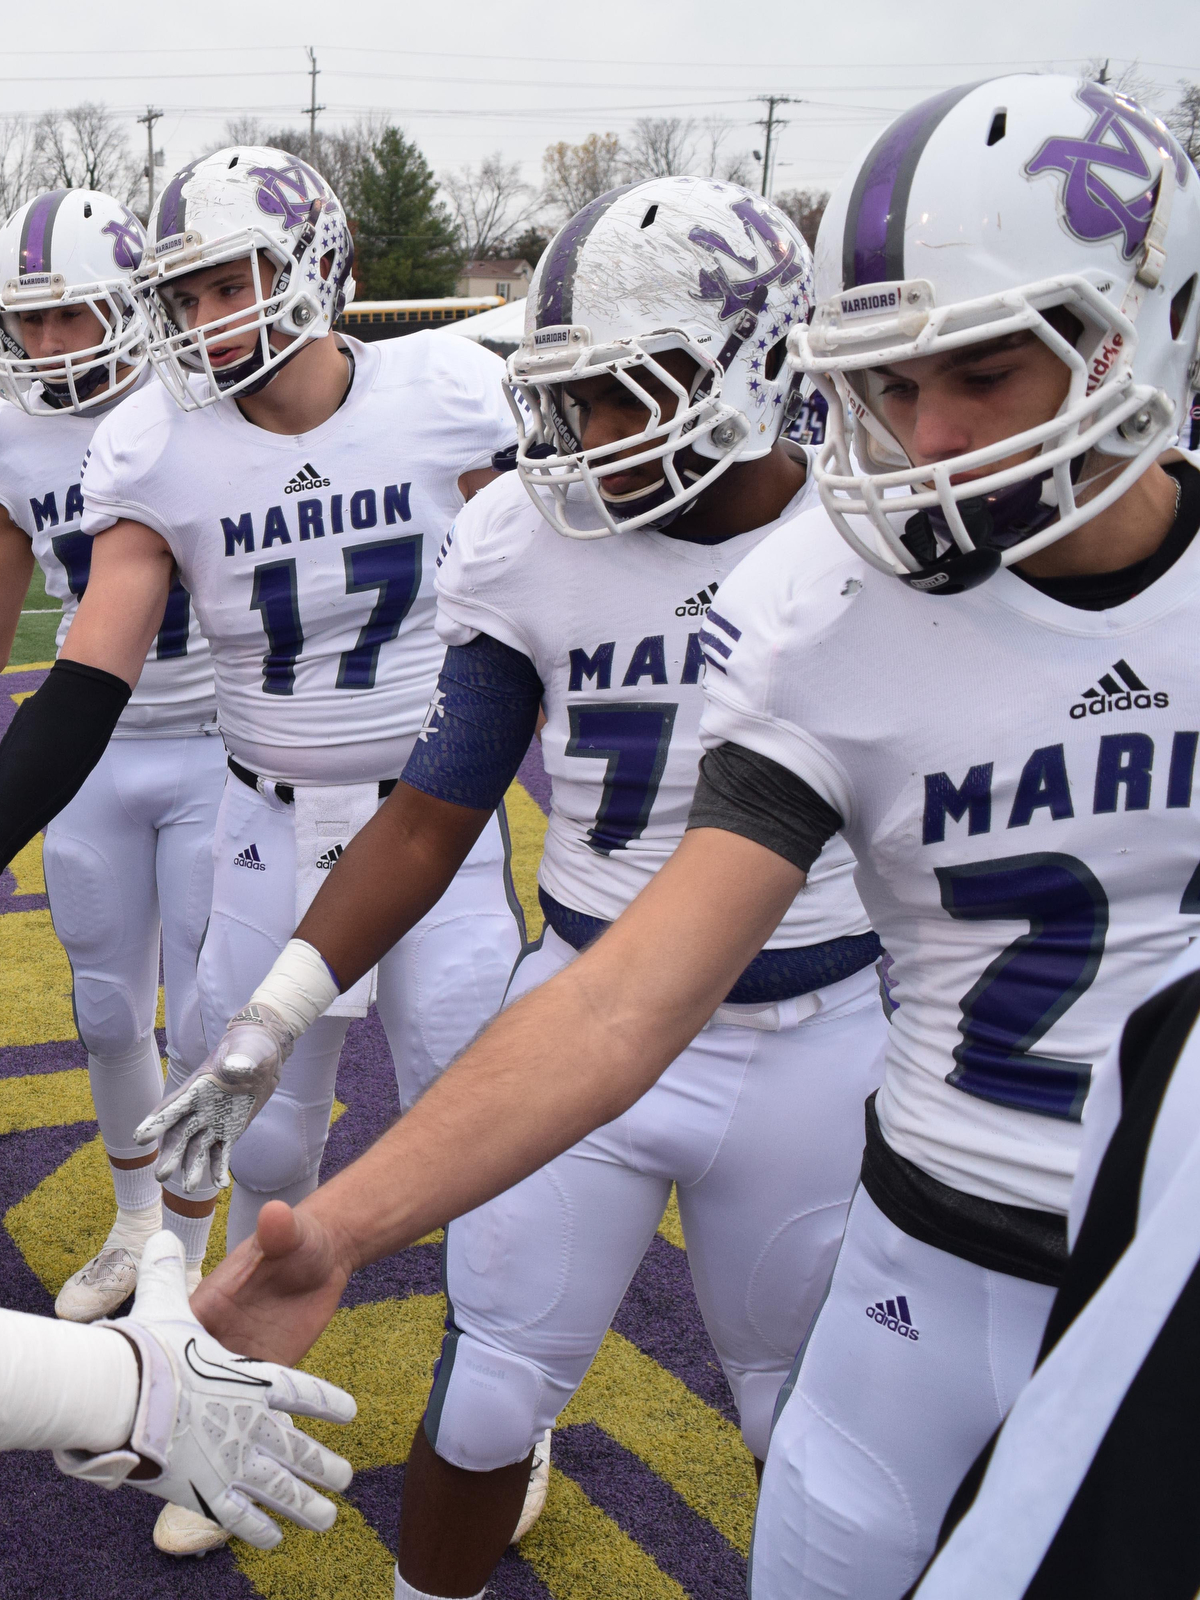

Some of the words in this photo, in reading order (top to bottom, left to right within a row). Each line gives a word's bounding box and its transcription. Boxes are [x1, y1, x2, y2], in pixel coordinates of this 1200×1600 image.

[19, 277, 49, 286] WARRIORS
[841, 293, 896, 314] WARRIORS
[535, 332, 567, 345] WARRIORS
[284, 478, 331, 494] adidas
[220, 482, 413, 557] MARION
[249, 532, 424, 696] 17
[1069, 690, 1170, 720] adidas
[564, 702, 679, 856] 7
[233, 857, 266, 871] adidas
[933, 850, 1200, 1124] 2
[865, 1305, 920, 1342] adidas
